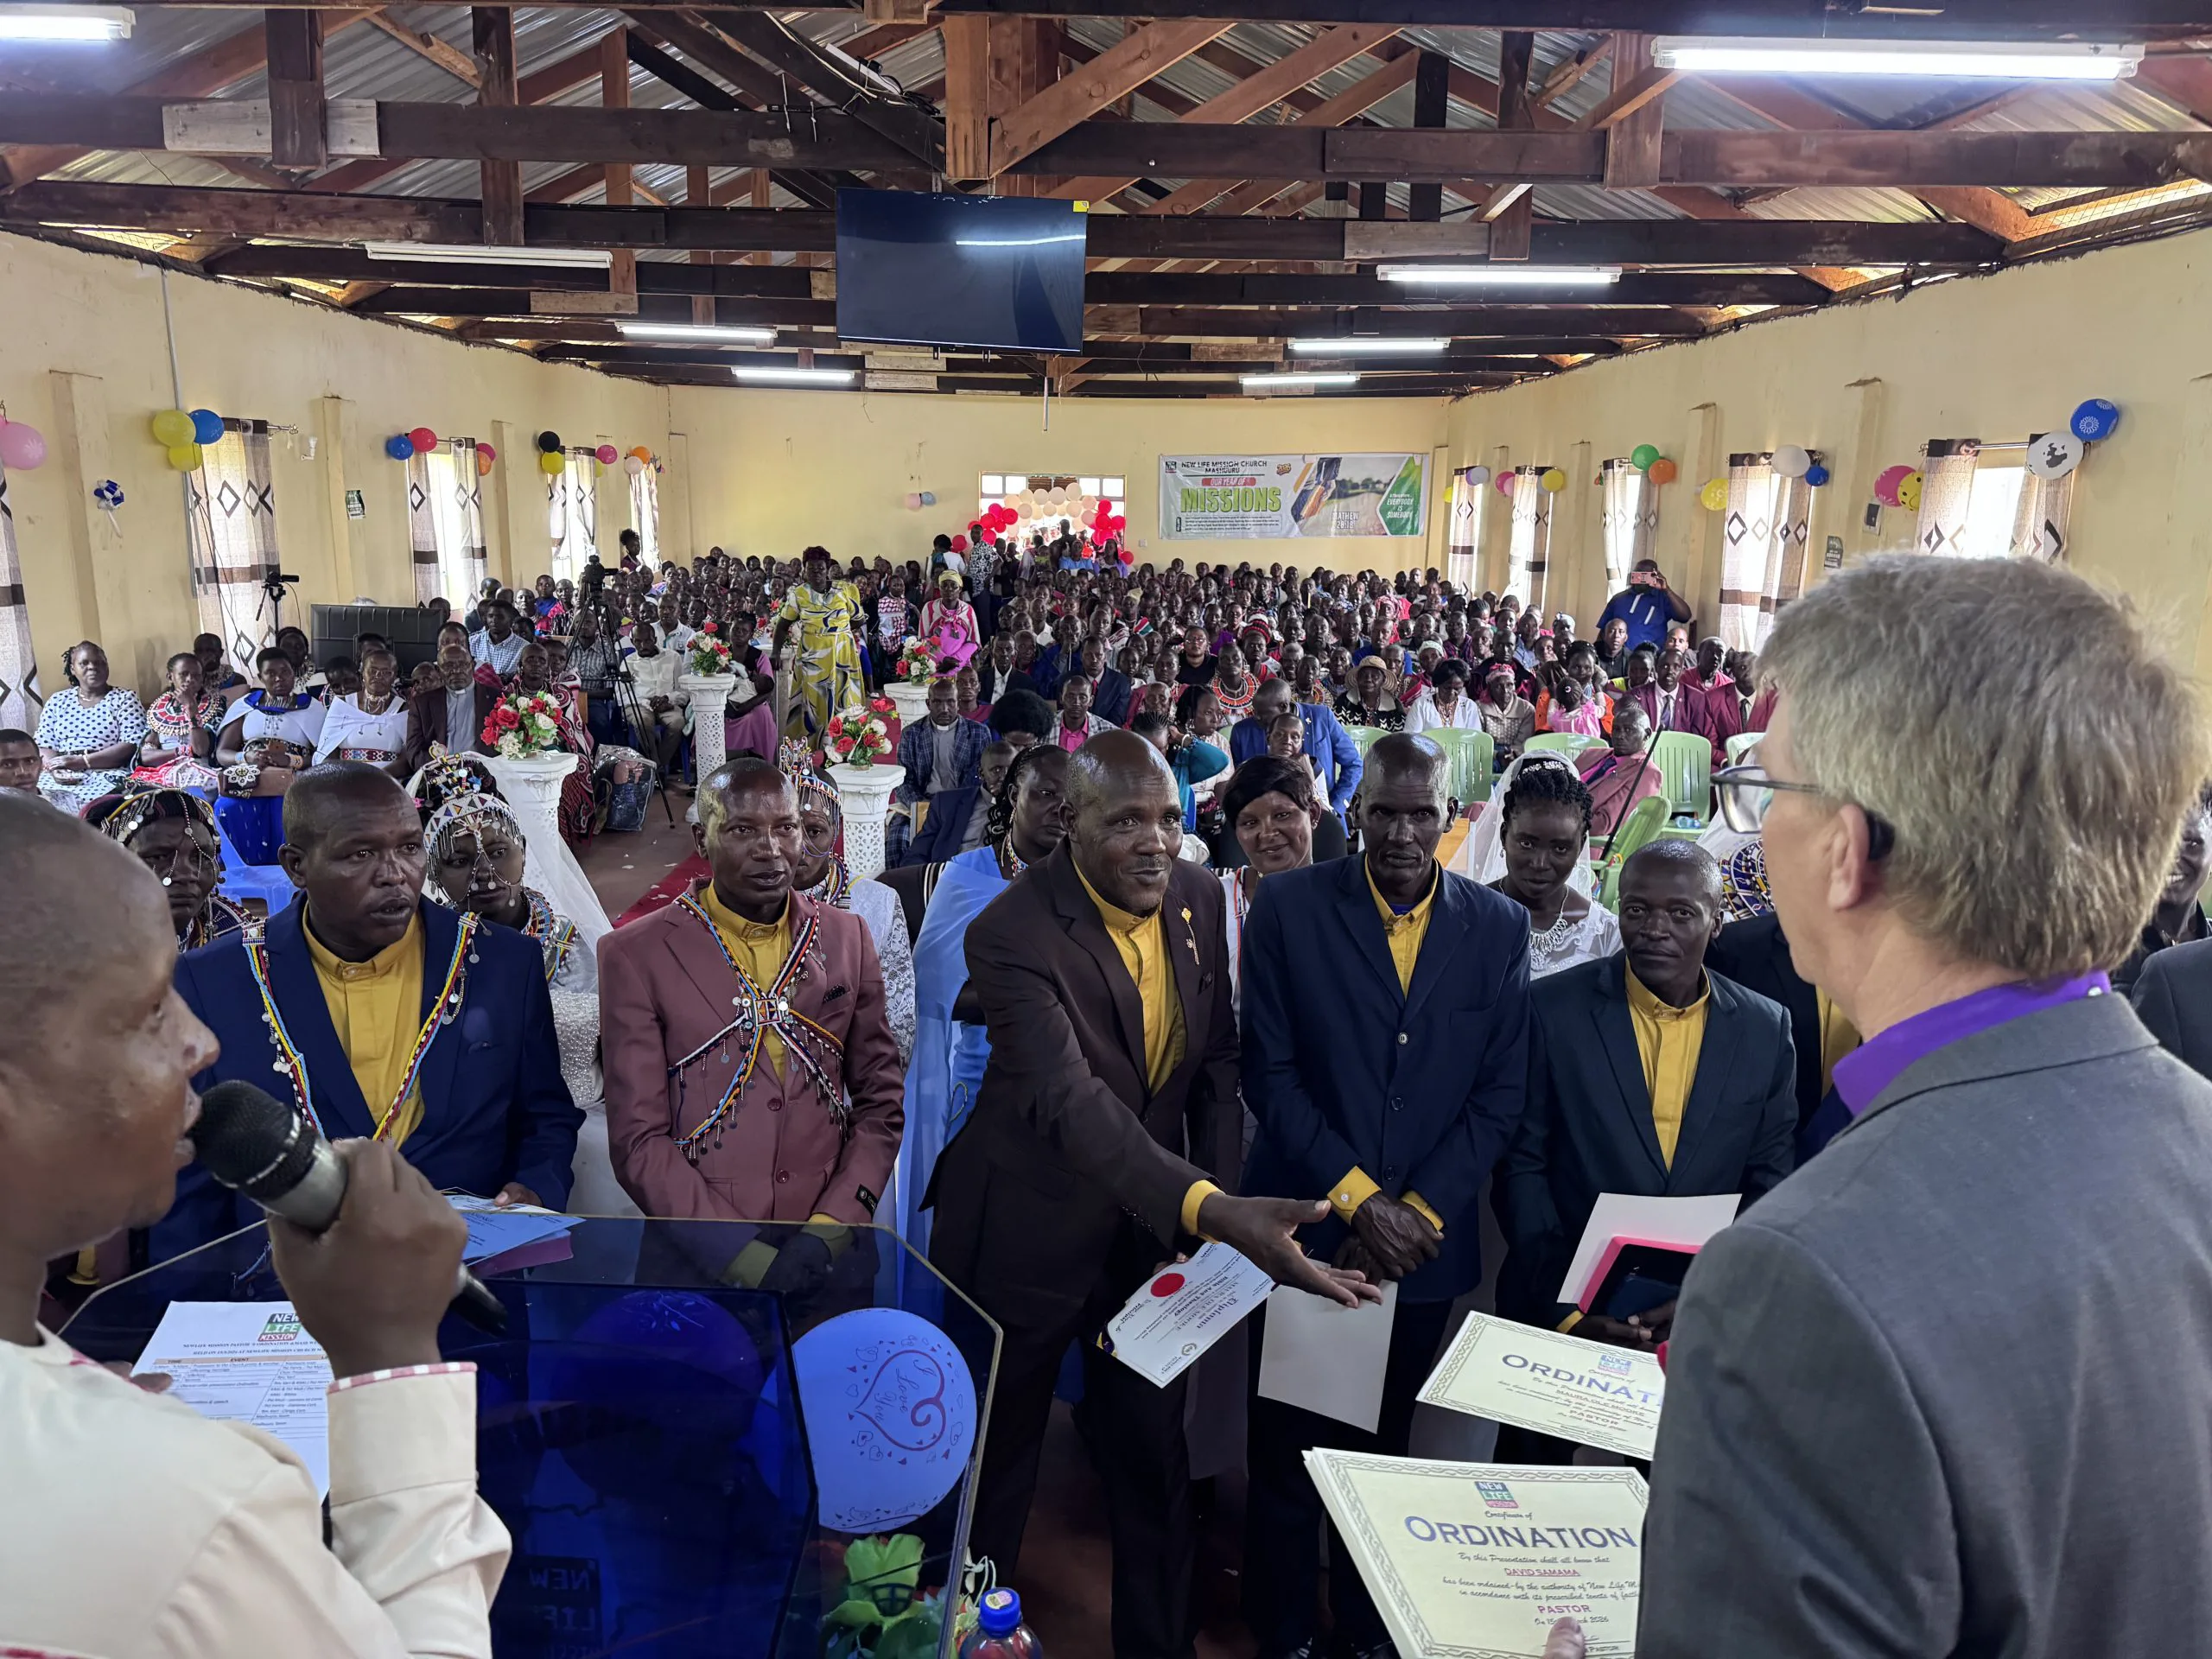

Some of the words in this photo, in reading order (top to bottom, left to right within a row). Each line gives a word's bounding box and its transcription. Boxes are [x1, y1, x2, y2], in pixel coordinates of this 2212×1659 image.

[1211, 477, 1223, 486] OUR
[1223, 477, 1237, 486] YEAR
[1237, 477, 1245, 486] OF
[1180, 486, 1281, 512] MISSIONS
[1332, 512, 1359, 521] MATHEW
[1173, 1295, 1200, 1317] Theology
[264, 1324, 298, 1333] LIFE
[1502, 1354, 1660, 1406] ORDINAT
[895, 1368, 920, 1414] Love
[874, 1390, 897, 1423] You
[1568, 1409, 1620, 1426] PASTOR
[1478, 1482, 1504, 1491] NEW
[1481, 1491, 1512, 1500] LIFE
[1523, 1511, 1533, 1520] of
[1404, 1516, 1638, 1548] ORDINATION
[1458, 1552, 1471, 1561] By
[1459, 1578, 1476, 1586] been
[1577, 1583, 1586, 1592] of
[1610, 1592, 1619, 1601] of
[1537, 1605, 1592, 1614] PASTOR
